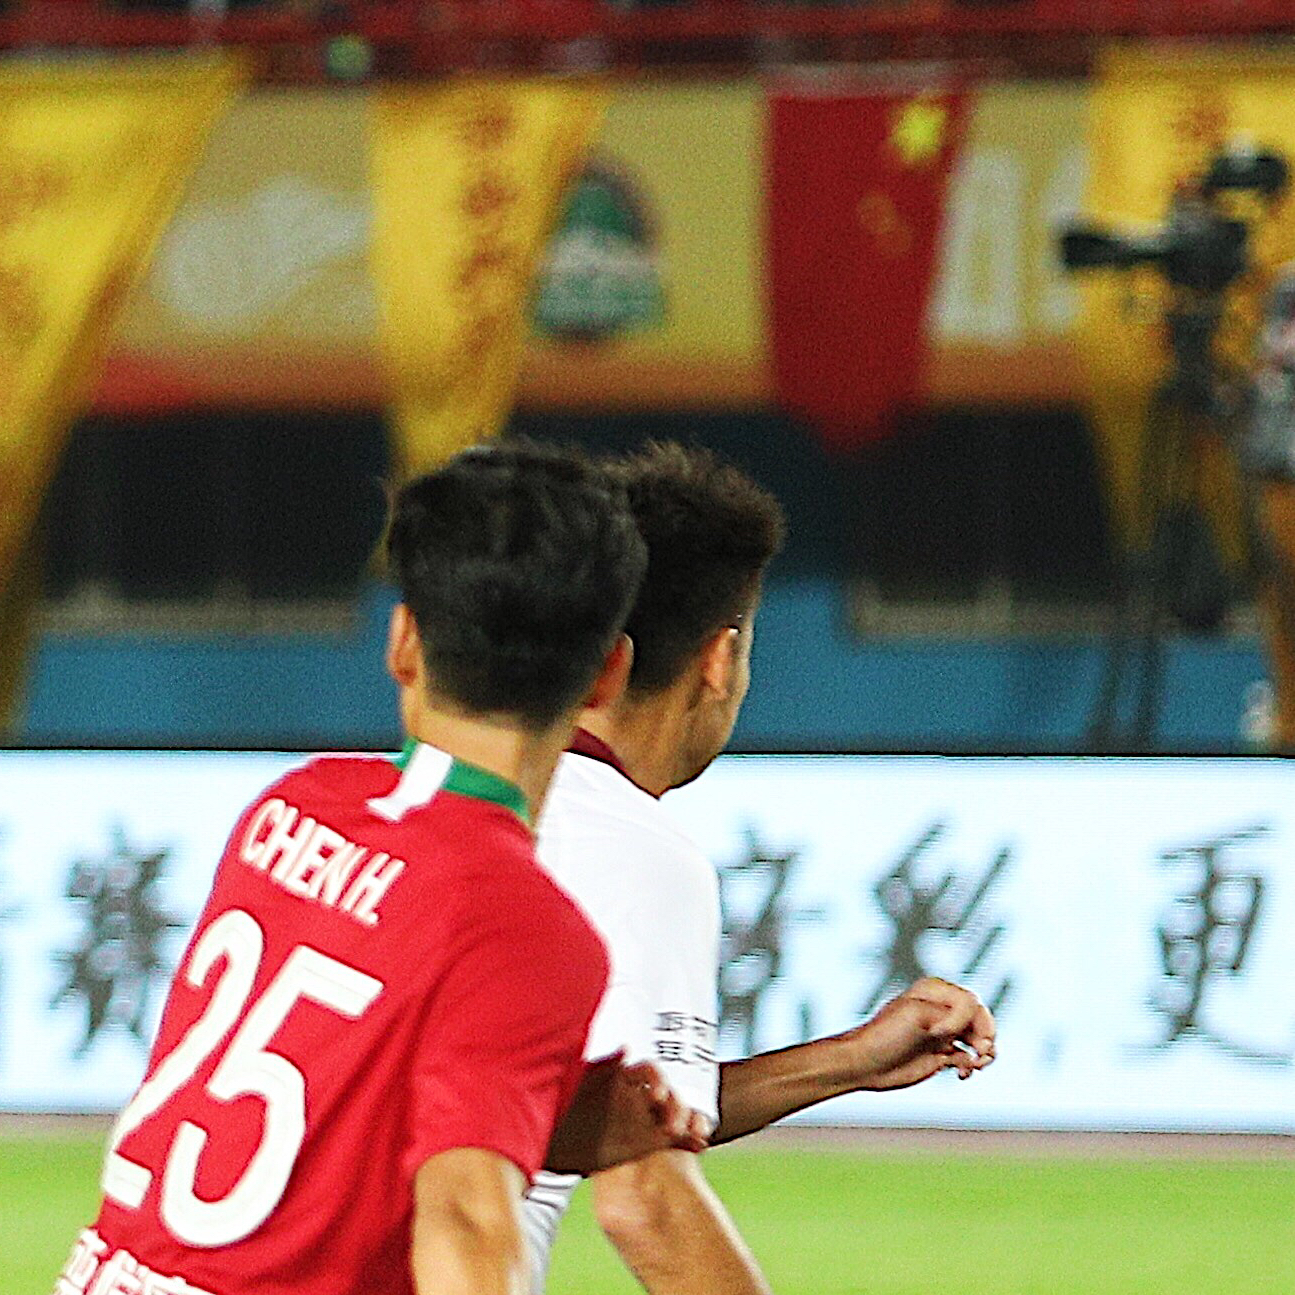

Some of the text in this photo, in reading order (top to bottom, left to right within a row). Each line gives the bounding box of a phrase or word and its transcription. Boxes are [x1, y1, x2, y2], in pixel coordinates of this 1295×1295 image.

[240, 797, 406, 928] CHEN H.
[100, 908, 384, 1249] 25
